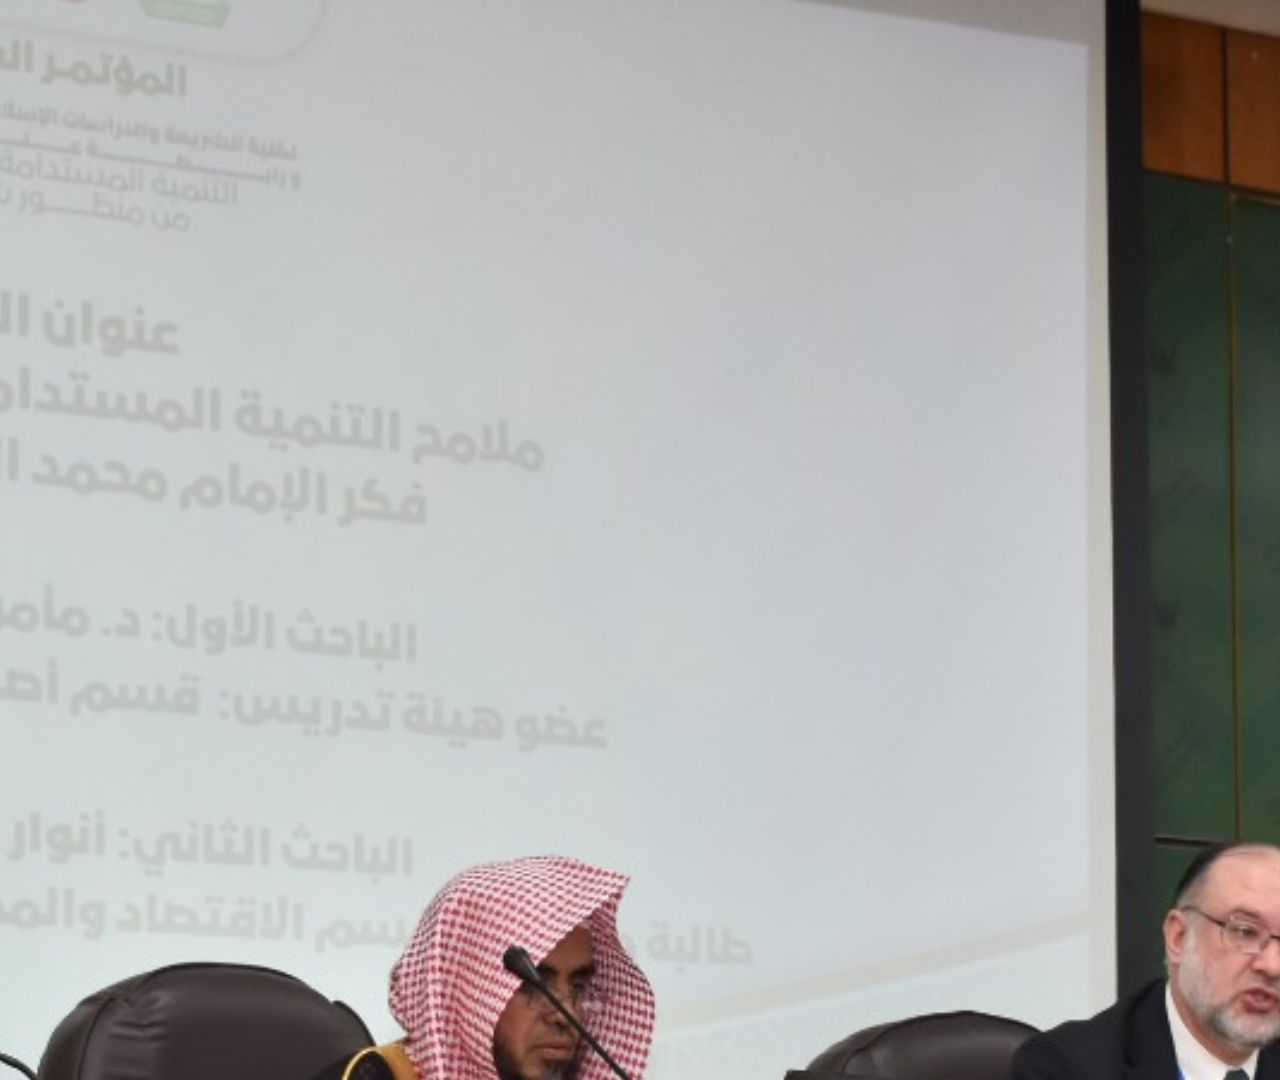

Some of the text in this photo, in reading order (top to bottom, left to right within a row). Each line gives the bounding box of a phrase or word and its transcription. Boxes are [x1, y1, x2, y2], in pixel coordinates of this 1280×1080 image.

[40, 52, 187, 98] المؤتمر
[41, 299, 180, 358] عنوان
[232, 389, 400, 452] التنمية
[412, 417, 545, 473] ملامح
[30, 453, 169, 504] محمد
[179, 461, 328, 524] الإمام
[337, 477, 427, 528] فكر
[100, 608, 142, 640] د.
[152, 598, 275, 656] الأول:
[285, 607, 417, 672] الباحث
[69, 672, 203, 718] قسم
[217, 688, 396, 738] تدريس:
[400, 691, 505, 749] هيئة
[513, 705, 608, 754] عضو
[6, 808, 108, 865] أنوار
[117, 817, 271, 879] الثاني:
[281, 821, 414, 888] الباحث
[115, 895, 305, 937] الاقتصاد
[314, 919, 409, 954] سم
[646, 917, 755, 974] طالبة
